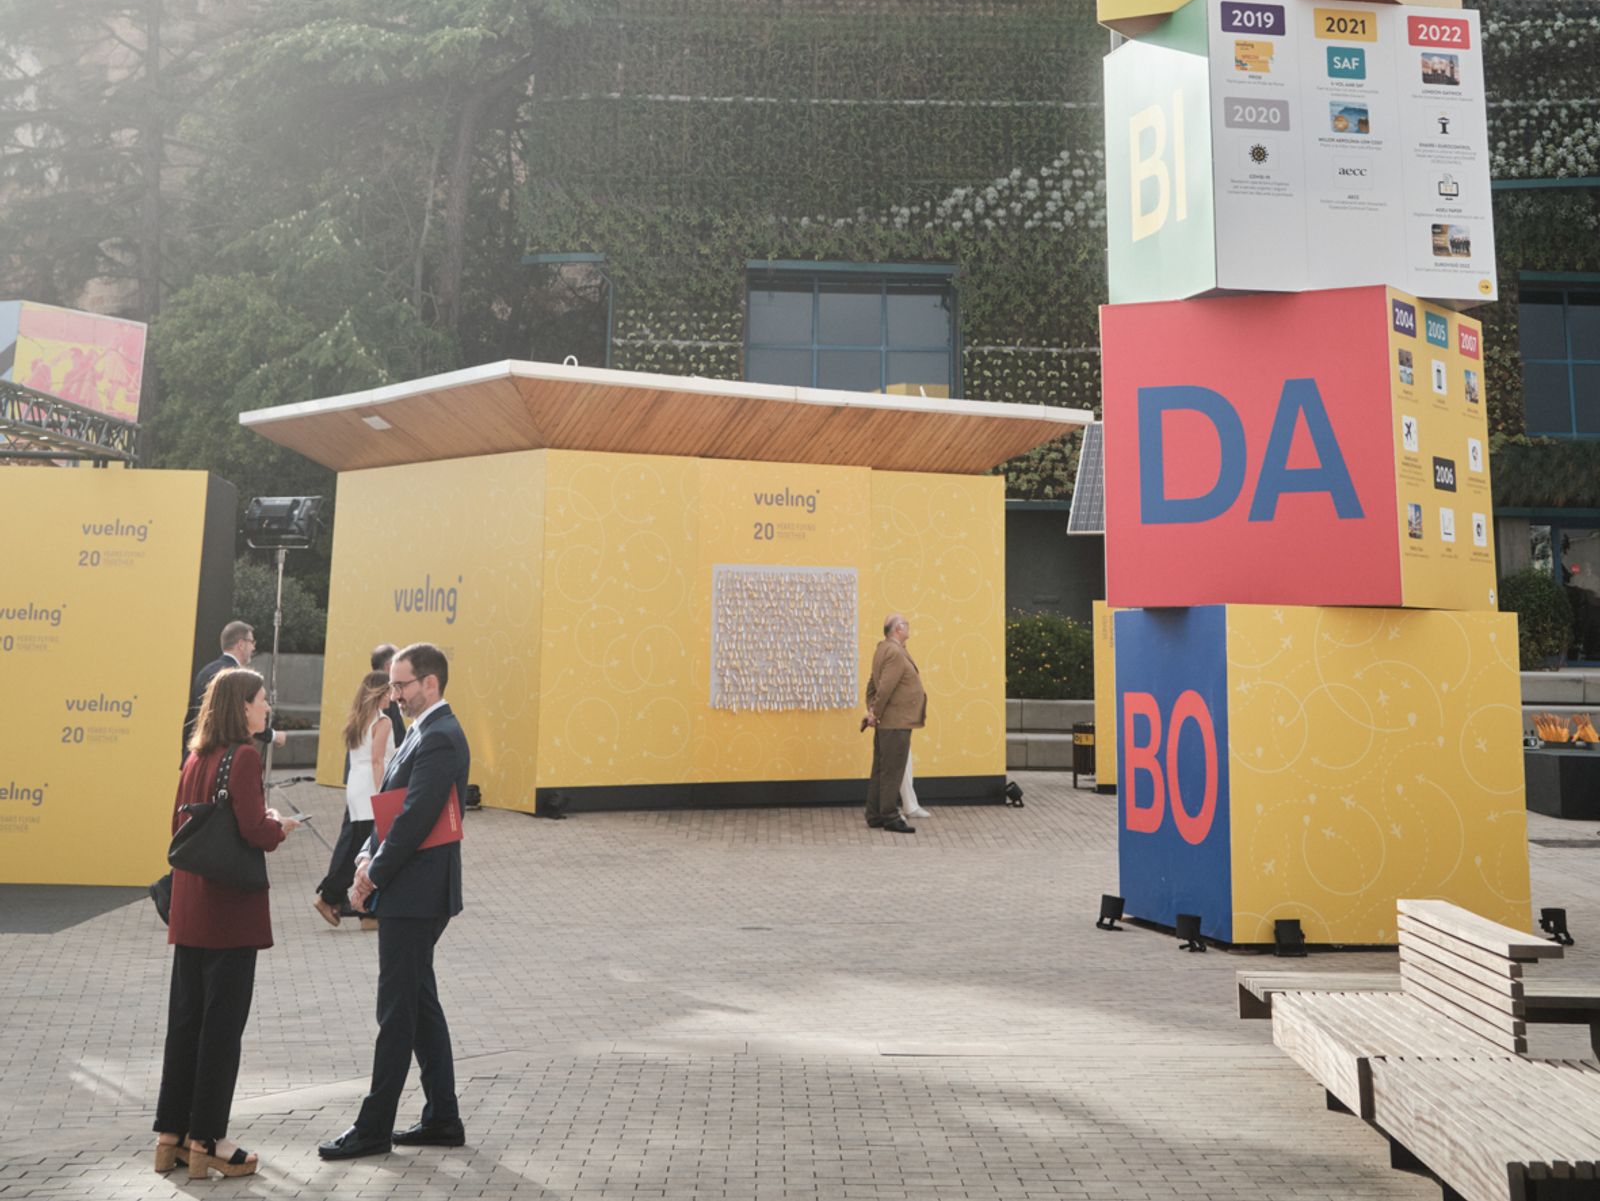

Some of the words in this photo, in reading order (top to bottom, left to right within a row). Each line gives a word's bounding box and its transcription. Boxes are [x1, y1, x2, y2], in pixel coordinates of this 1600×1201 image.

[1231, 9, 1275, 29] 2019
[1325, 16, 1366, 35] 2021
[1417, 23, 1462, 43] 2022
[1333, 55, 1360, 71] SAF
[1233, 104, 1281, 125] 2020
[1129, 87, 1187, 243] BI
[1394, 307, 1414, 331] 2004
[1428, 320, 1447, 342] 2005
[1461, 332, 1477, 353] 2007
[1137, 378, 1366, 525] DA
[1435, 465, 1454, 486] 2006
[754, 487, 820, 514] vueling
[82, 518, 153, 543] vueling
[753, 522, 775, 541] 20
[78, 550, 101, 567] 20
[394, 573, 463, 625] vueling
[0, 635, 14, 652] 0
[65, 694, 138, 718] vueling
[61, 726, 85, 744] 20
[1123, 689, 1219, 846] BO
[0, 781, 48, 807] eling
